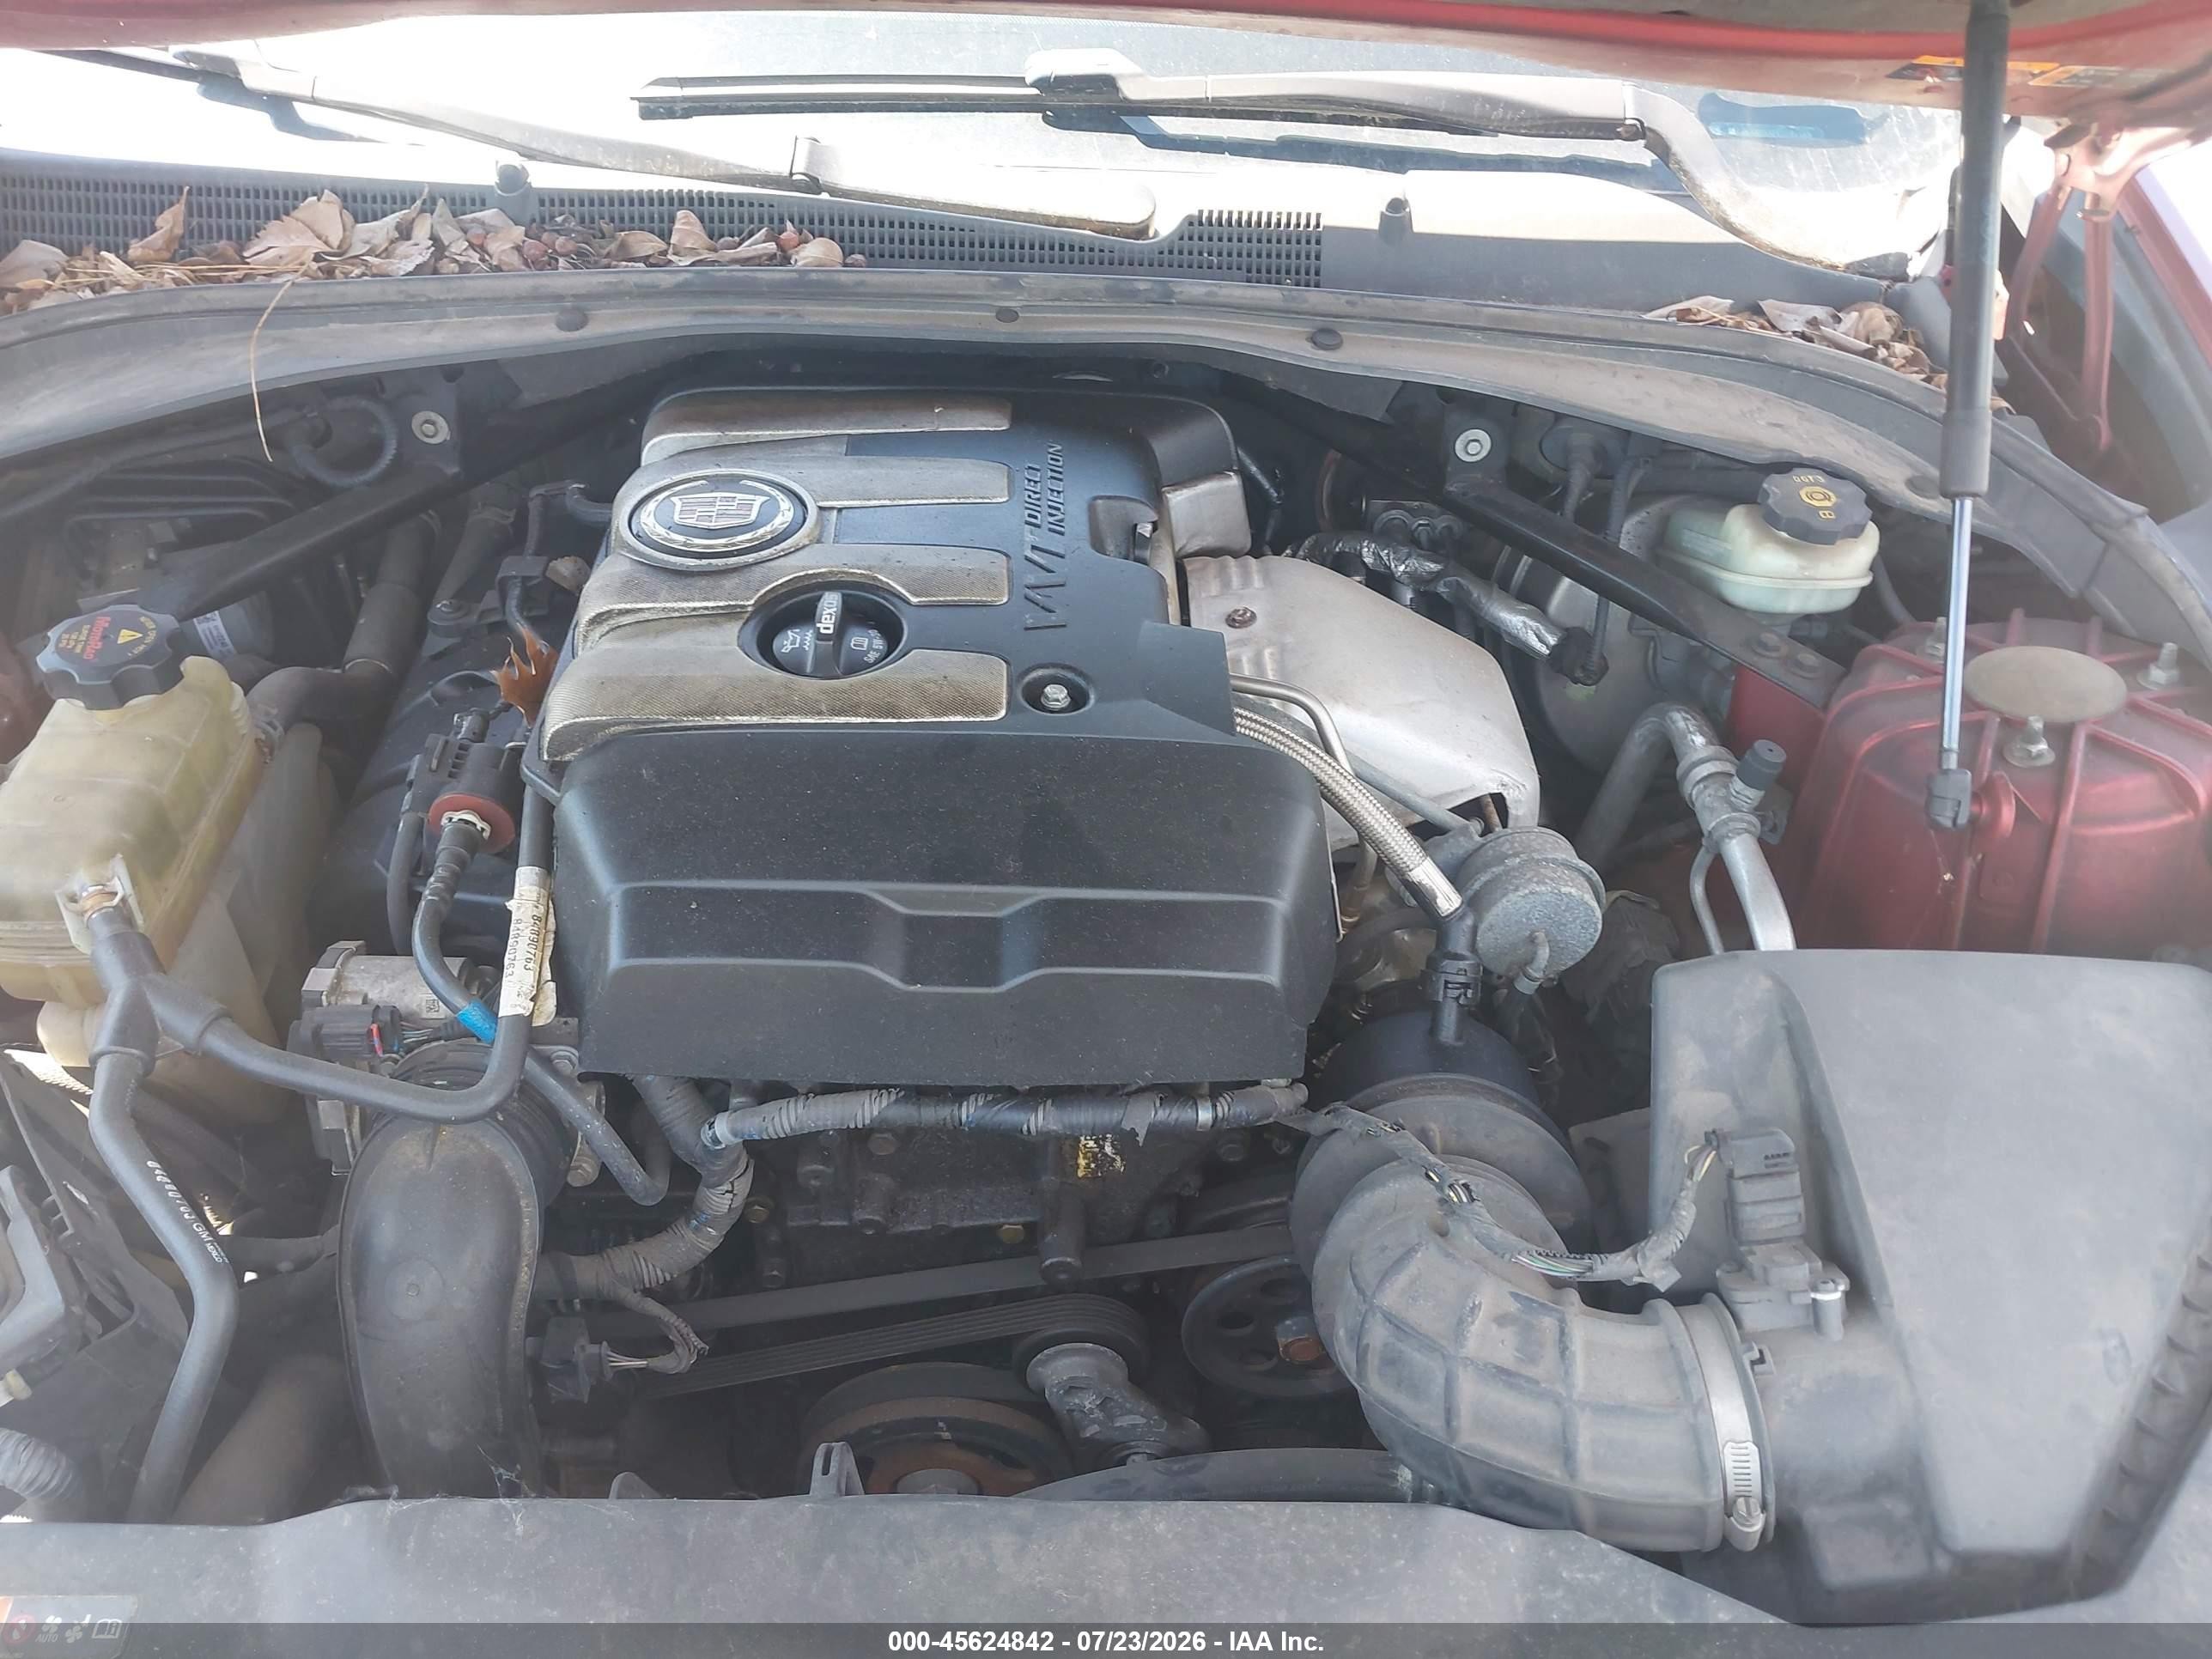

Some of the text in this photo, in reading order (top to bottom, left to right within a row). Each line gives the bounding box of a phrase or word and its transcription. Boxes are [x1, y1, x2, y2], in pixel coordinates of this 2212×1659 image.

[1024, 463, 1042, 529] DIRECT
[1047, 441, 1066, 537] INJECTION
[863, 650, 880, 664] SAE
[524, 914, 543, 972] 84890763
[35, 1633, 58, 1643] AUTO
